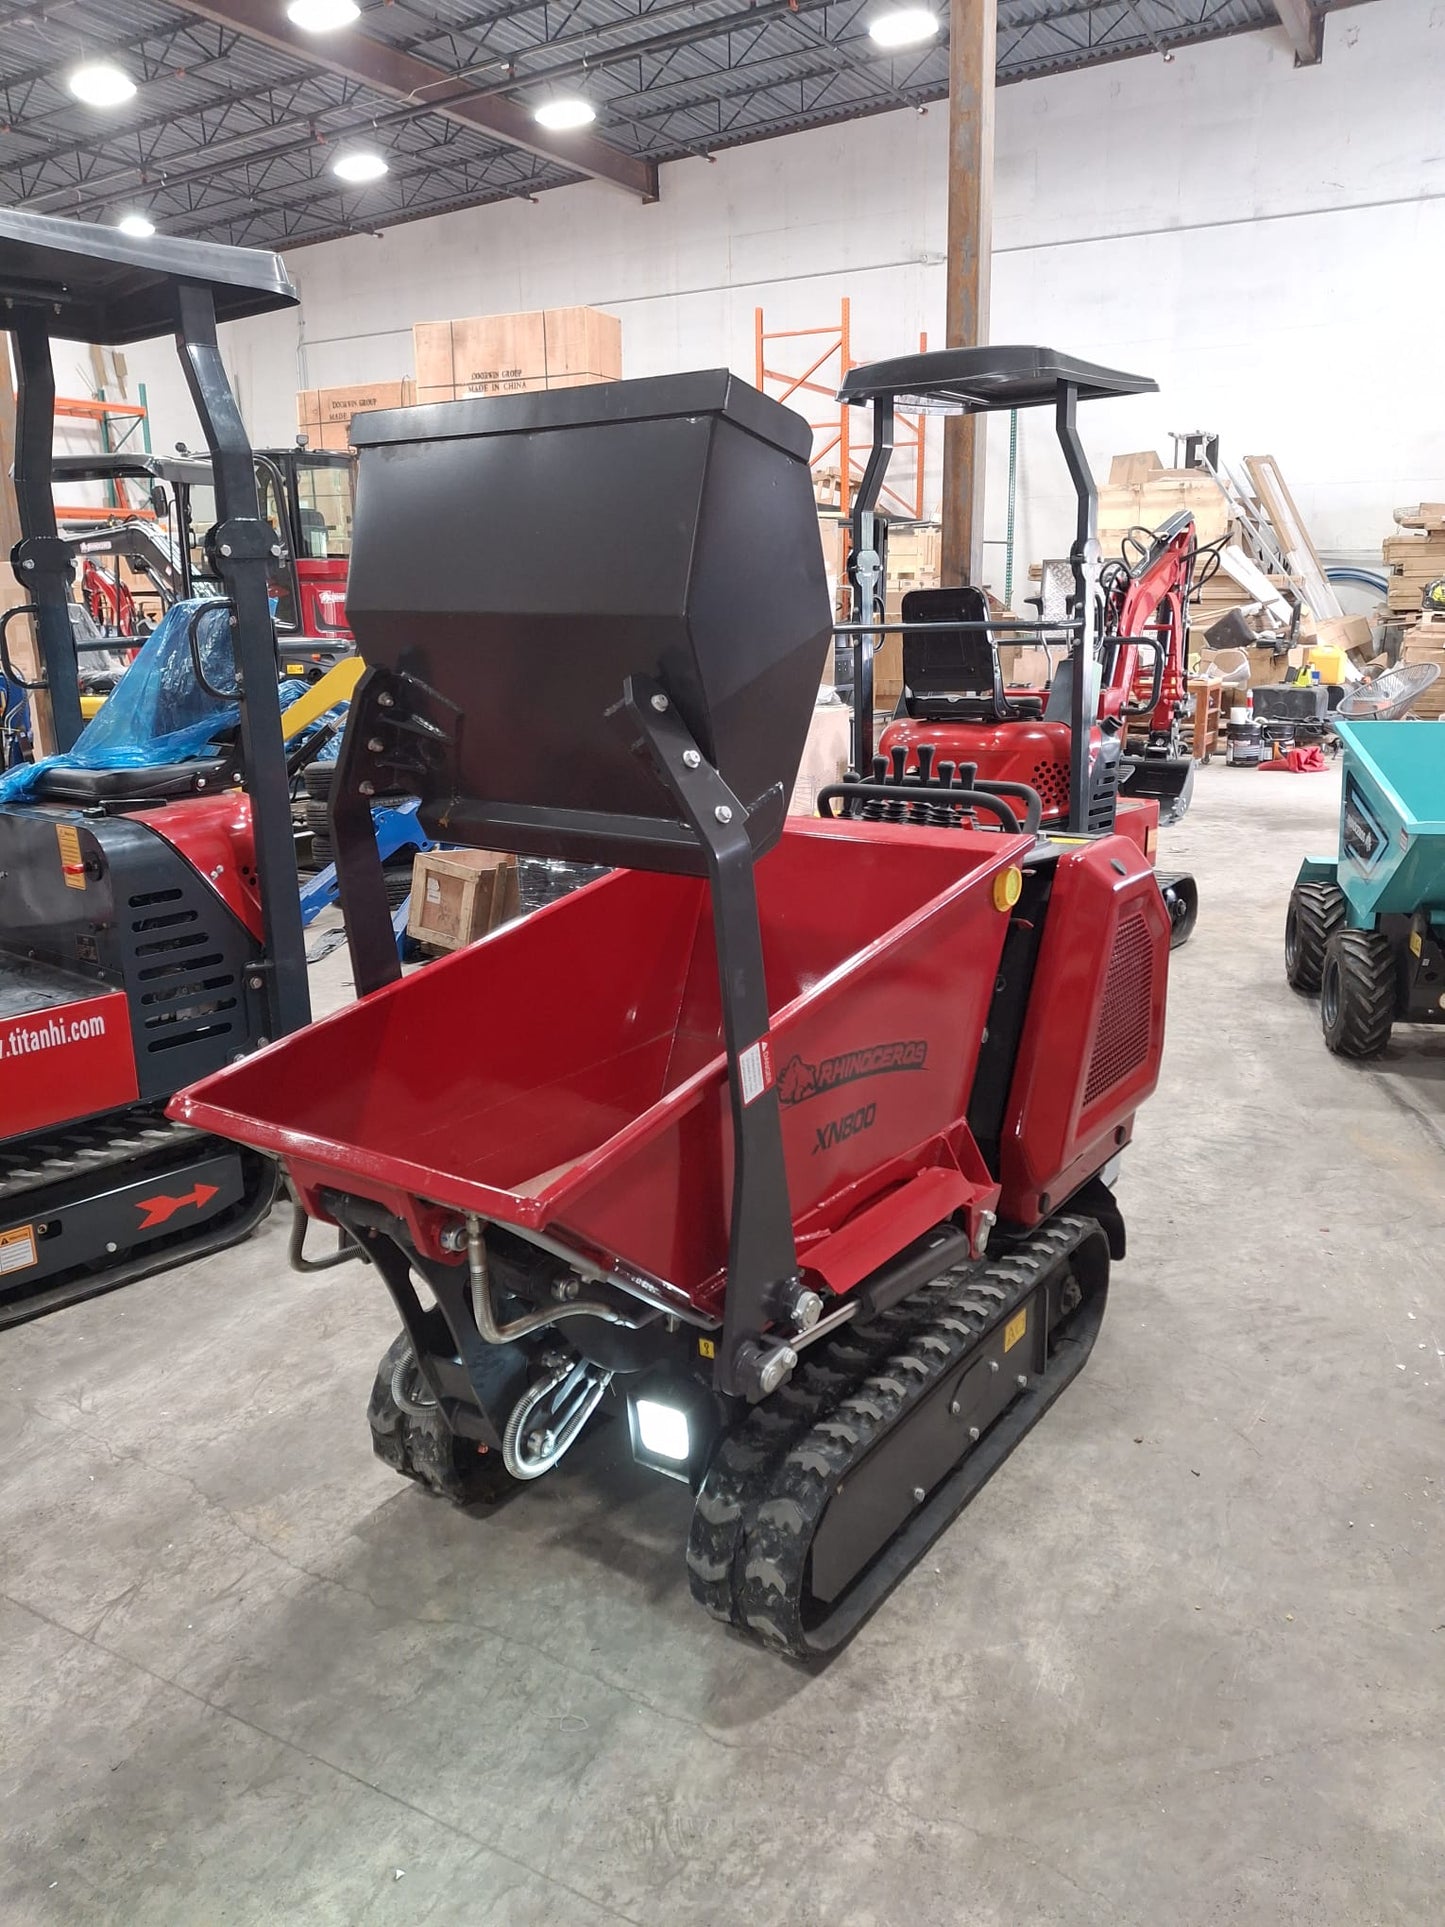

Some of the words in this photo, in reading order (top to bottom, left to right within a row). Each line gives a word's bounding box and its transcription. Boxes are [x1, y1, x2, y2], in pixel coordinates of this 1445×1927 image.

[468, 384, 489, 392] MADE
[492, 383, 500, 391] IN
[503, 381, 527, 390] CHINA
[502, 369, 522, 378] GROUP
[0, 1016, 105, 1059] .titanhi.com
[817, 1041, 928, 1089] RHINOCEROS
[812, 1103, 876, 1155] XN800
